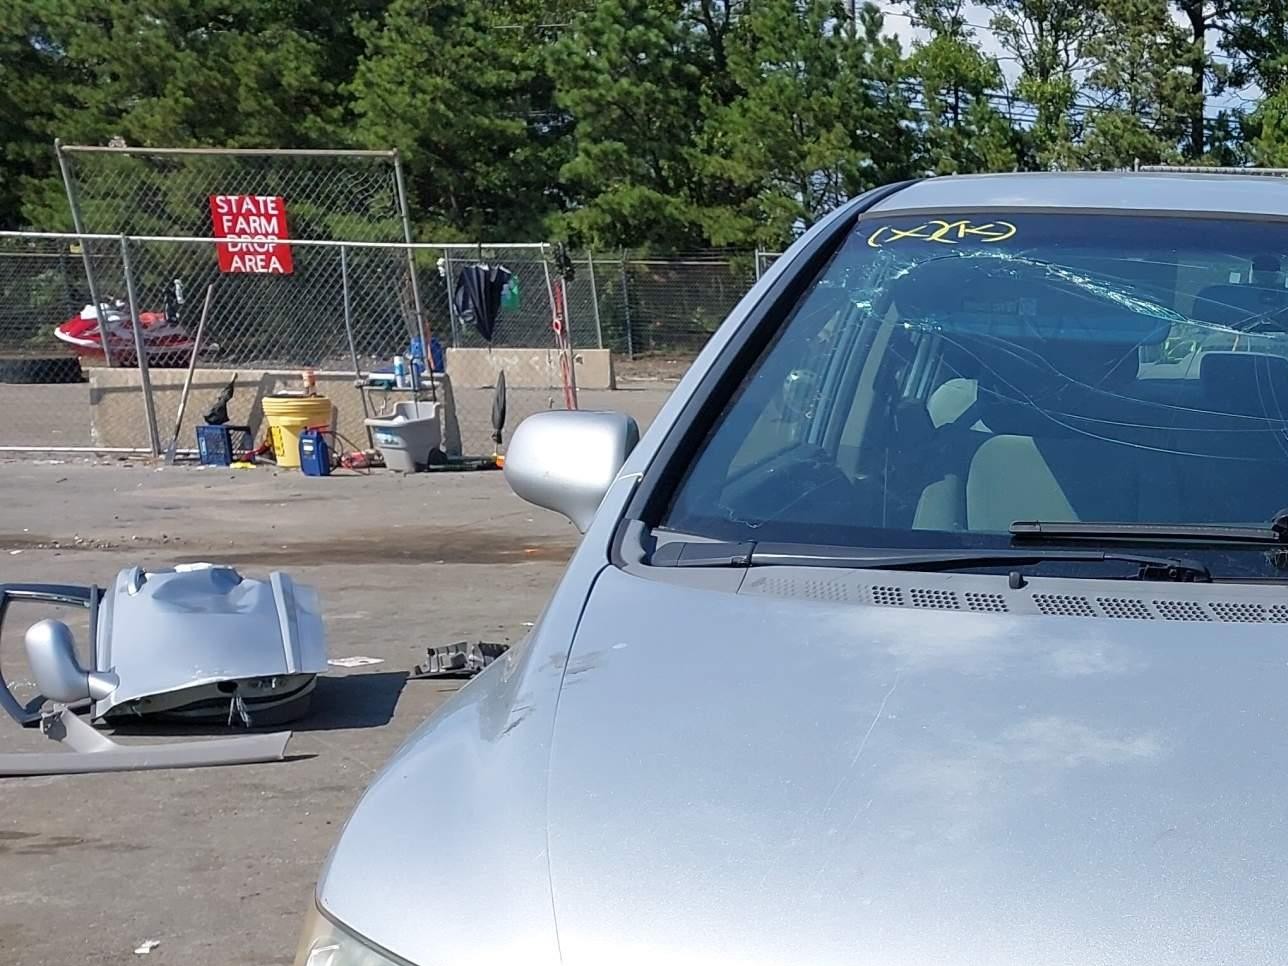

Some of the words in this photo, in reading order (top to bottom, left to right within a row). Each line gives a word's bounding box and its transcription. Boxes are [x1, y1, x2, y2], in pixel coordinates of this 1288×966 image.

[215, 195, 279, 214] STATE
[222, 215, 279, 234] FARM
[226, 234, 278, 253] DROP
[230, 254, 284, 273] AREA
